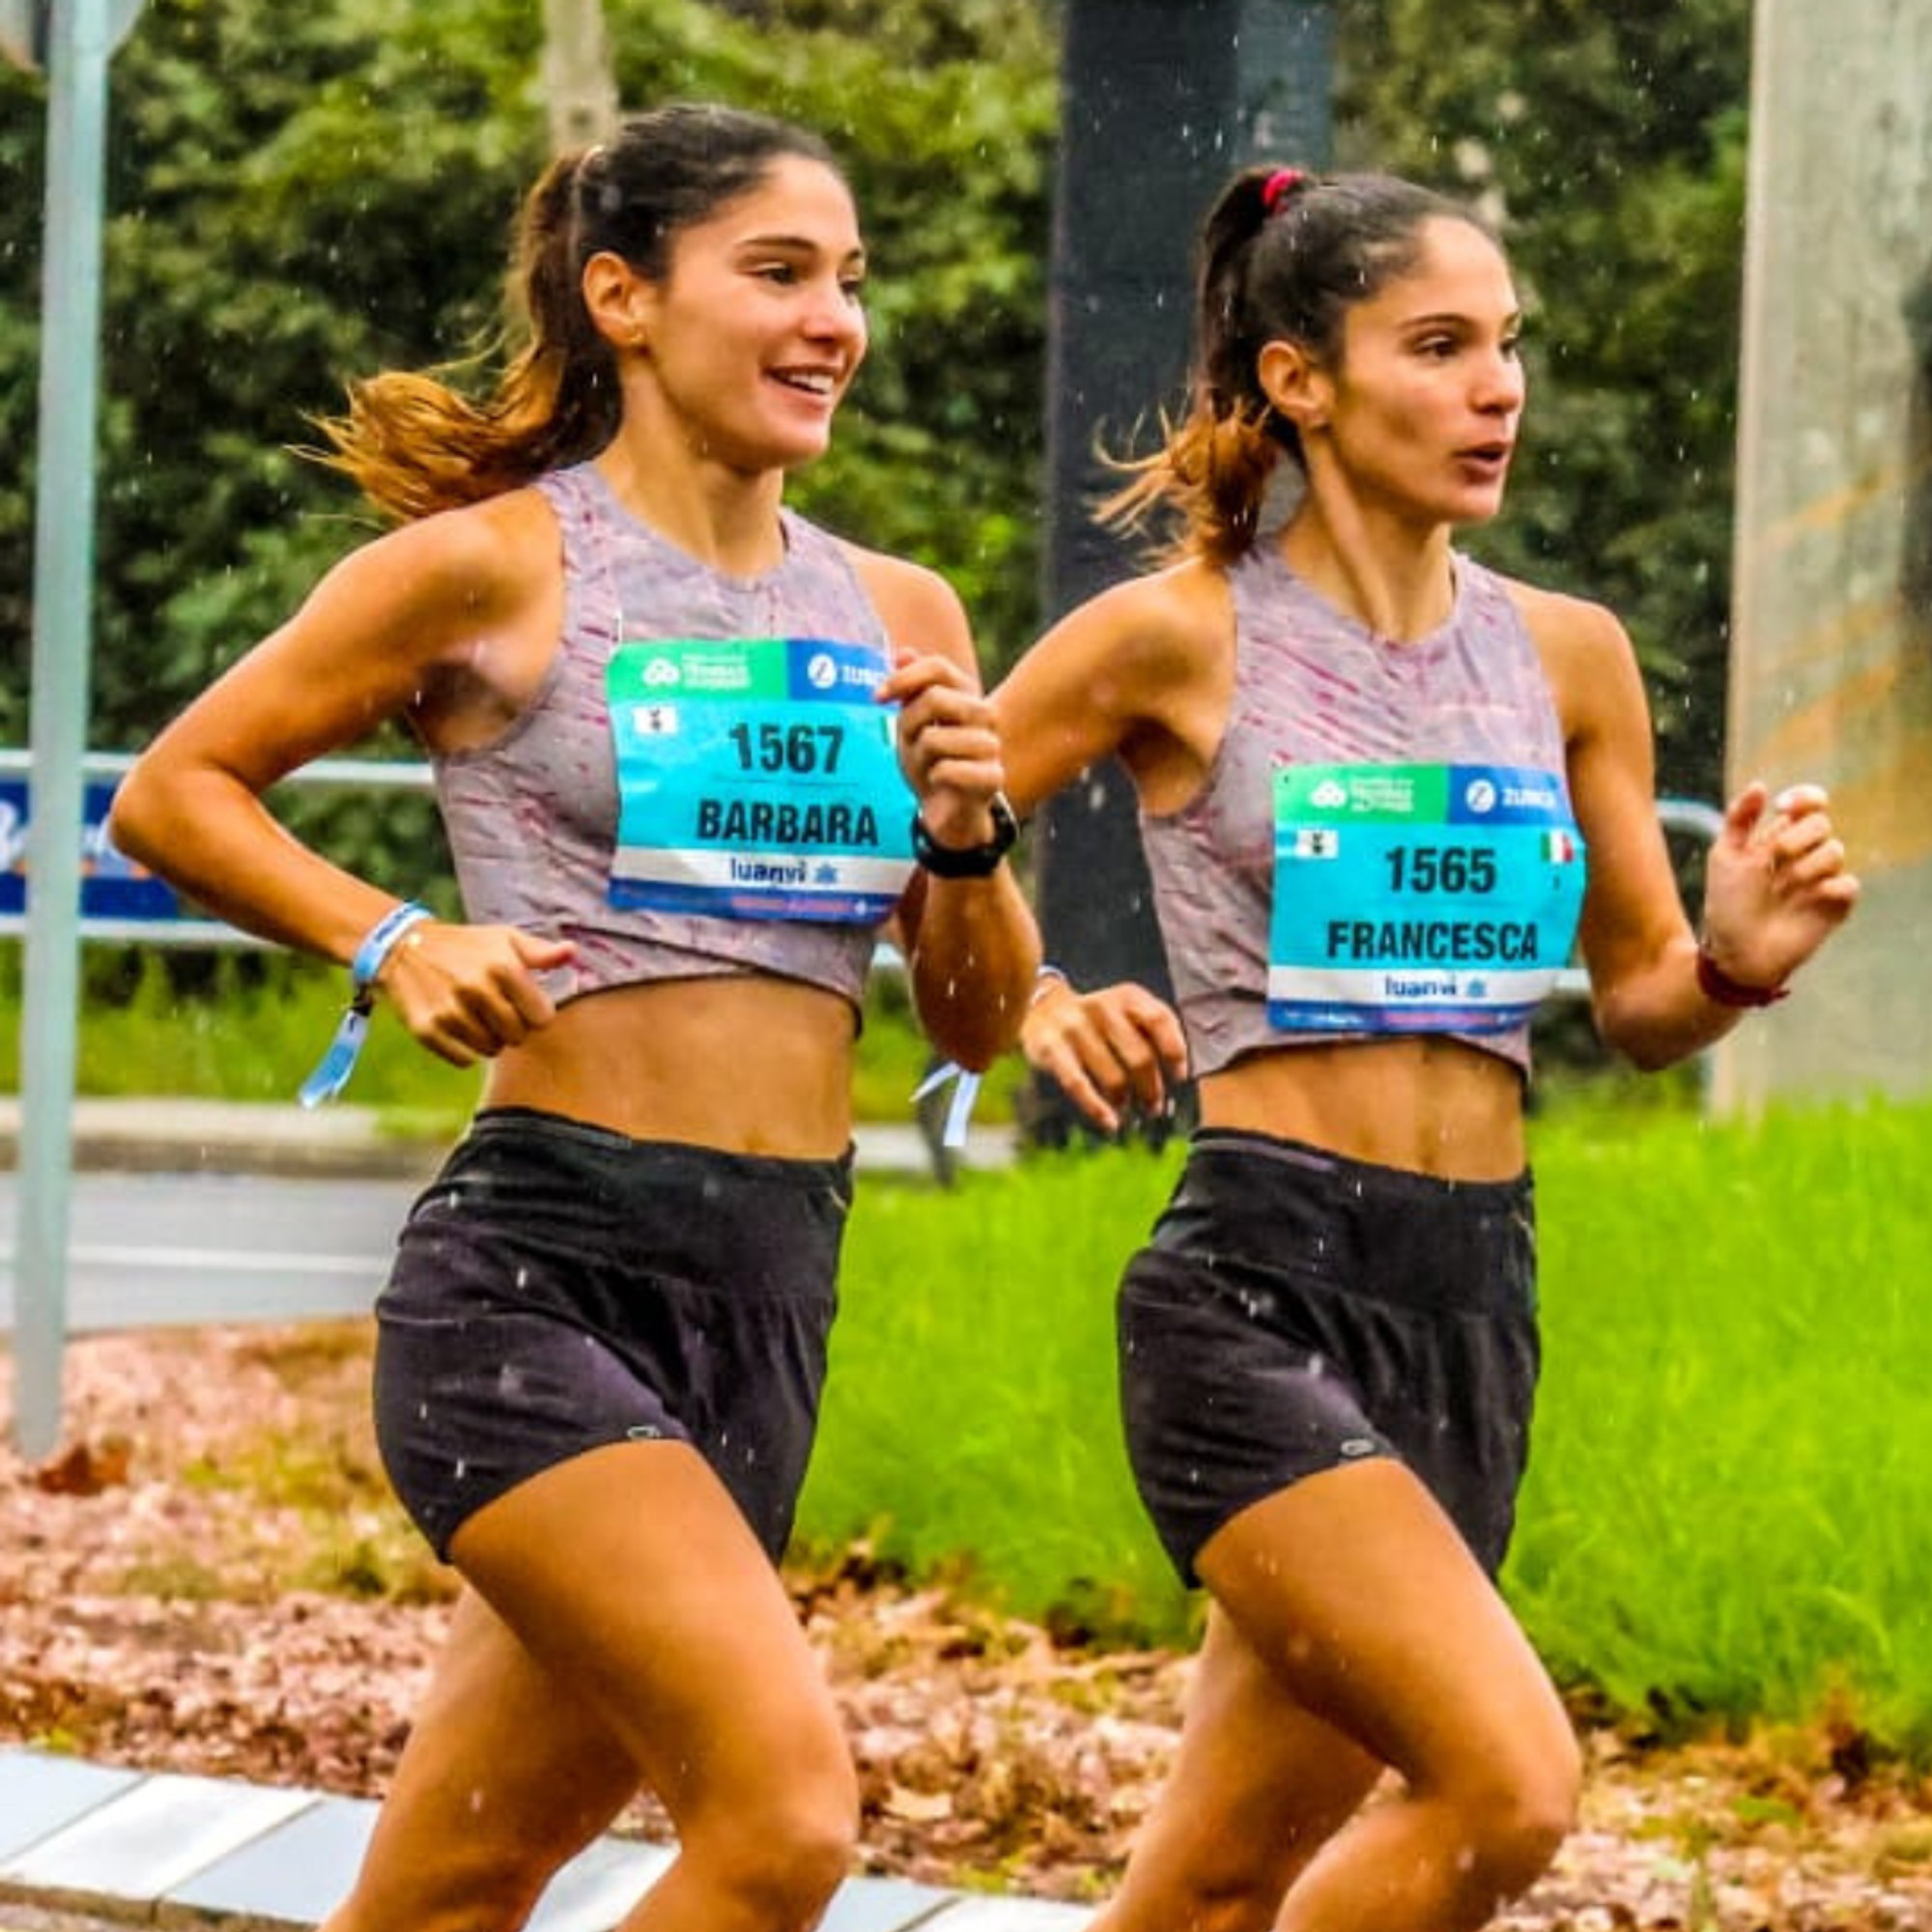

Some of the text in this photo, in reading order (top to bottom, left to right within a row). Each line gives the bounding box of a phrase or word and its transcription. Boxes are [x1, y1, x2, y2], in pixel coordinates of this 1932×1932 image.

[728, 722, 845, 775] 1567
[696, 799, 879, 847] BARBARA
[1385, 846, 1497, 895] 1565
[1326, 921, 1539, 961] FRANCESCA
